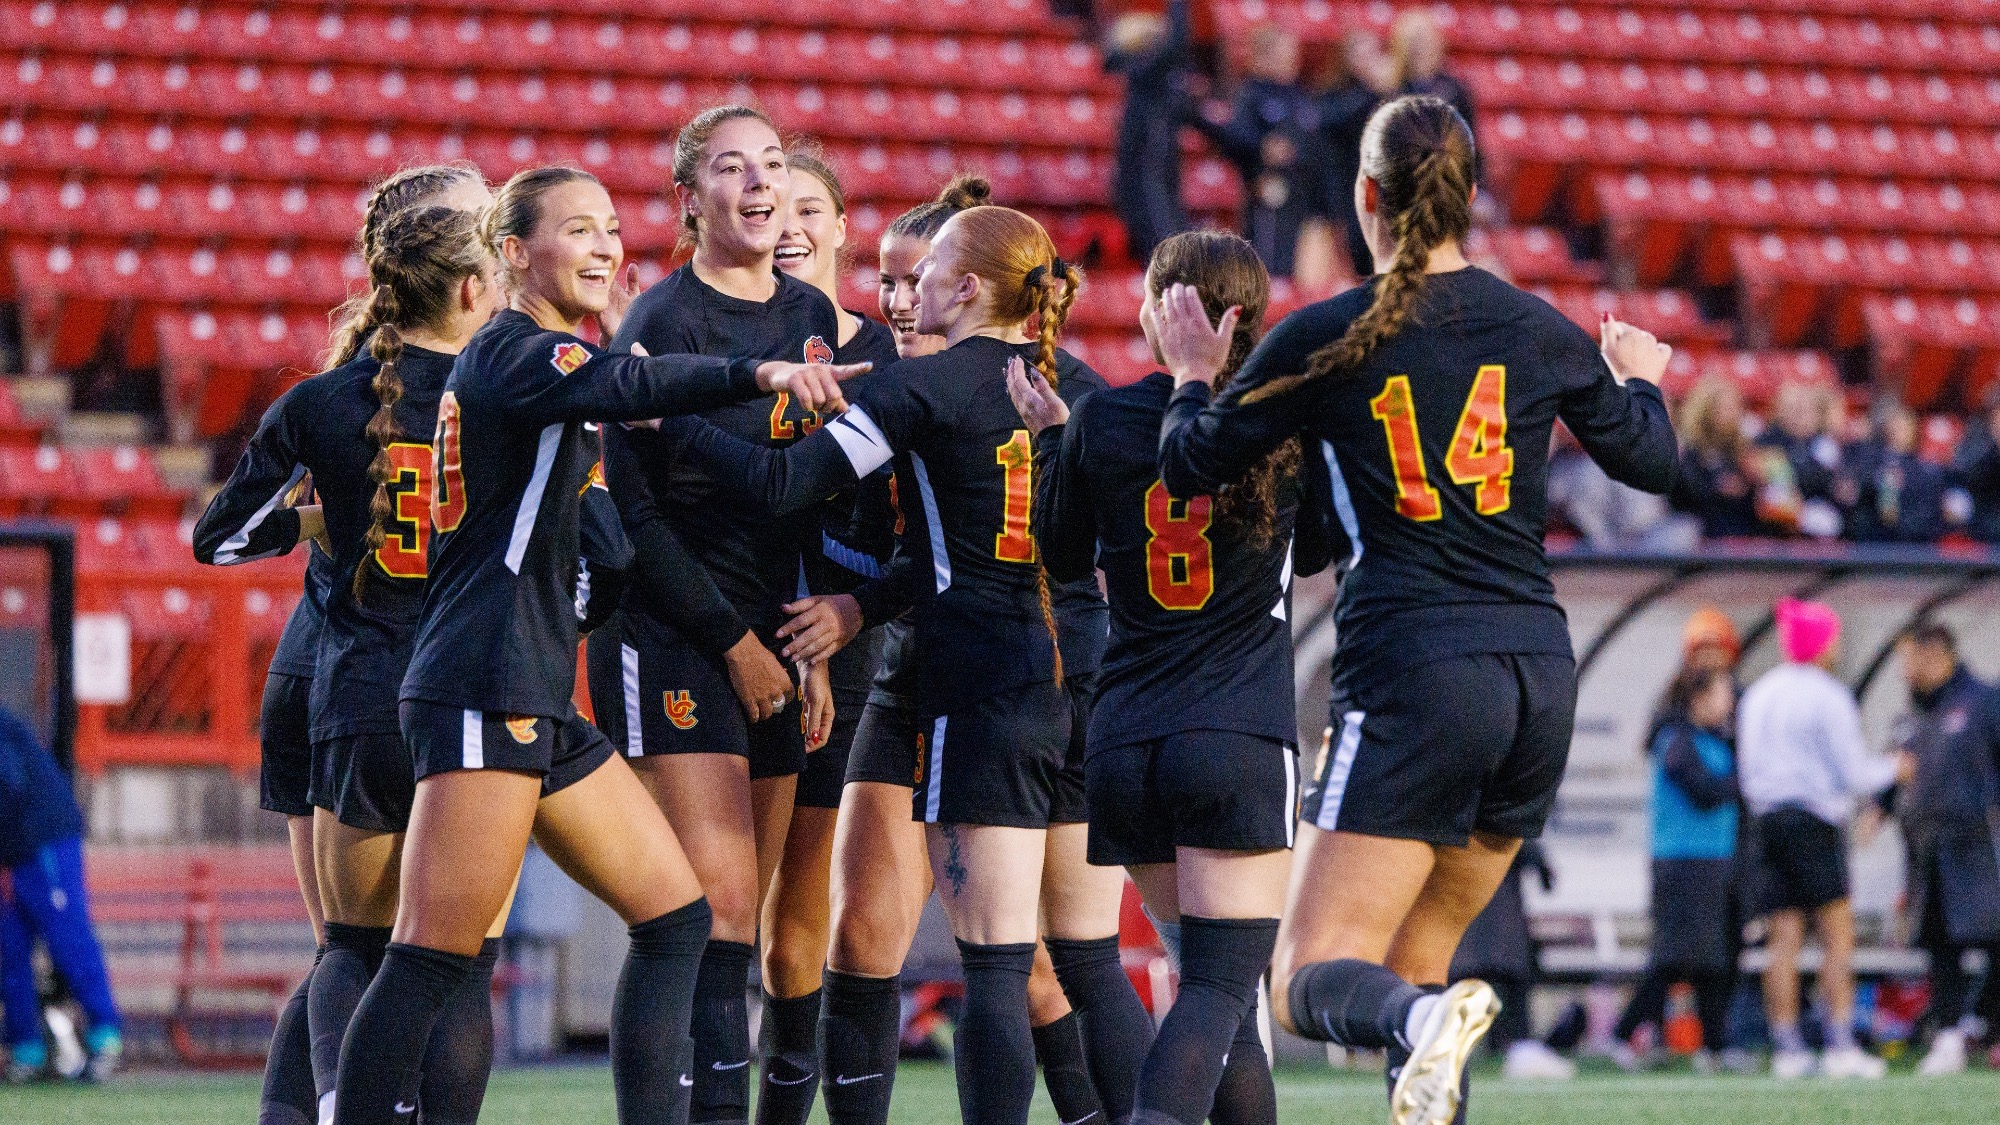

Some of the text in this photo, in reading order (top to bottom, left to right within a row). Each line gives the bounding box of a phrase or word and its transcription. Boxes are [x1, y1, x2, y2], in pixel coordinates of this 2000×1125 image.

[374, 443, 434, 579] 3
[1370, 365, 1514, 522] 14
[1145, 479, 1214, 611] 8
